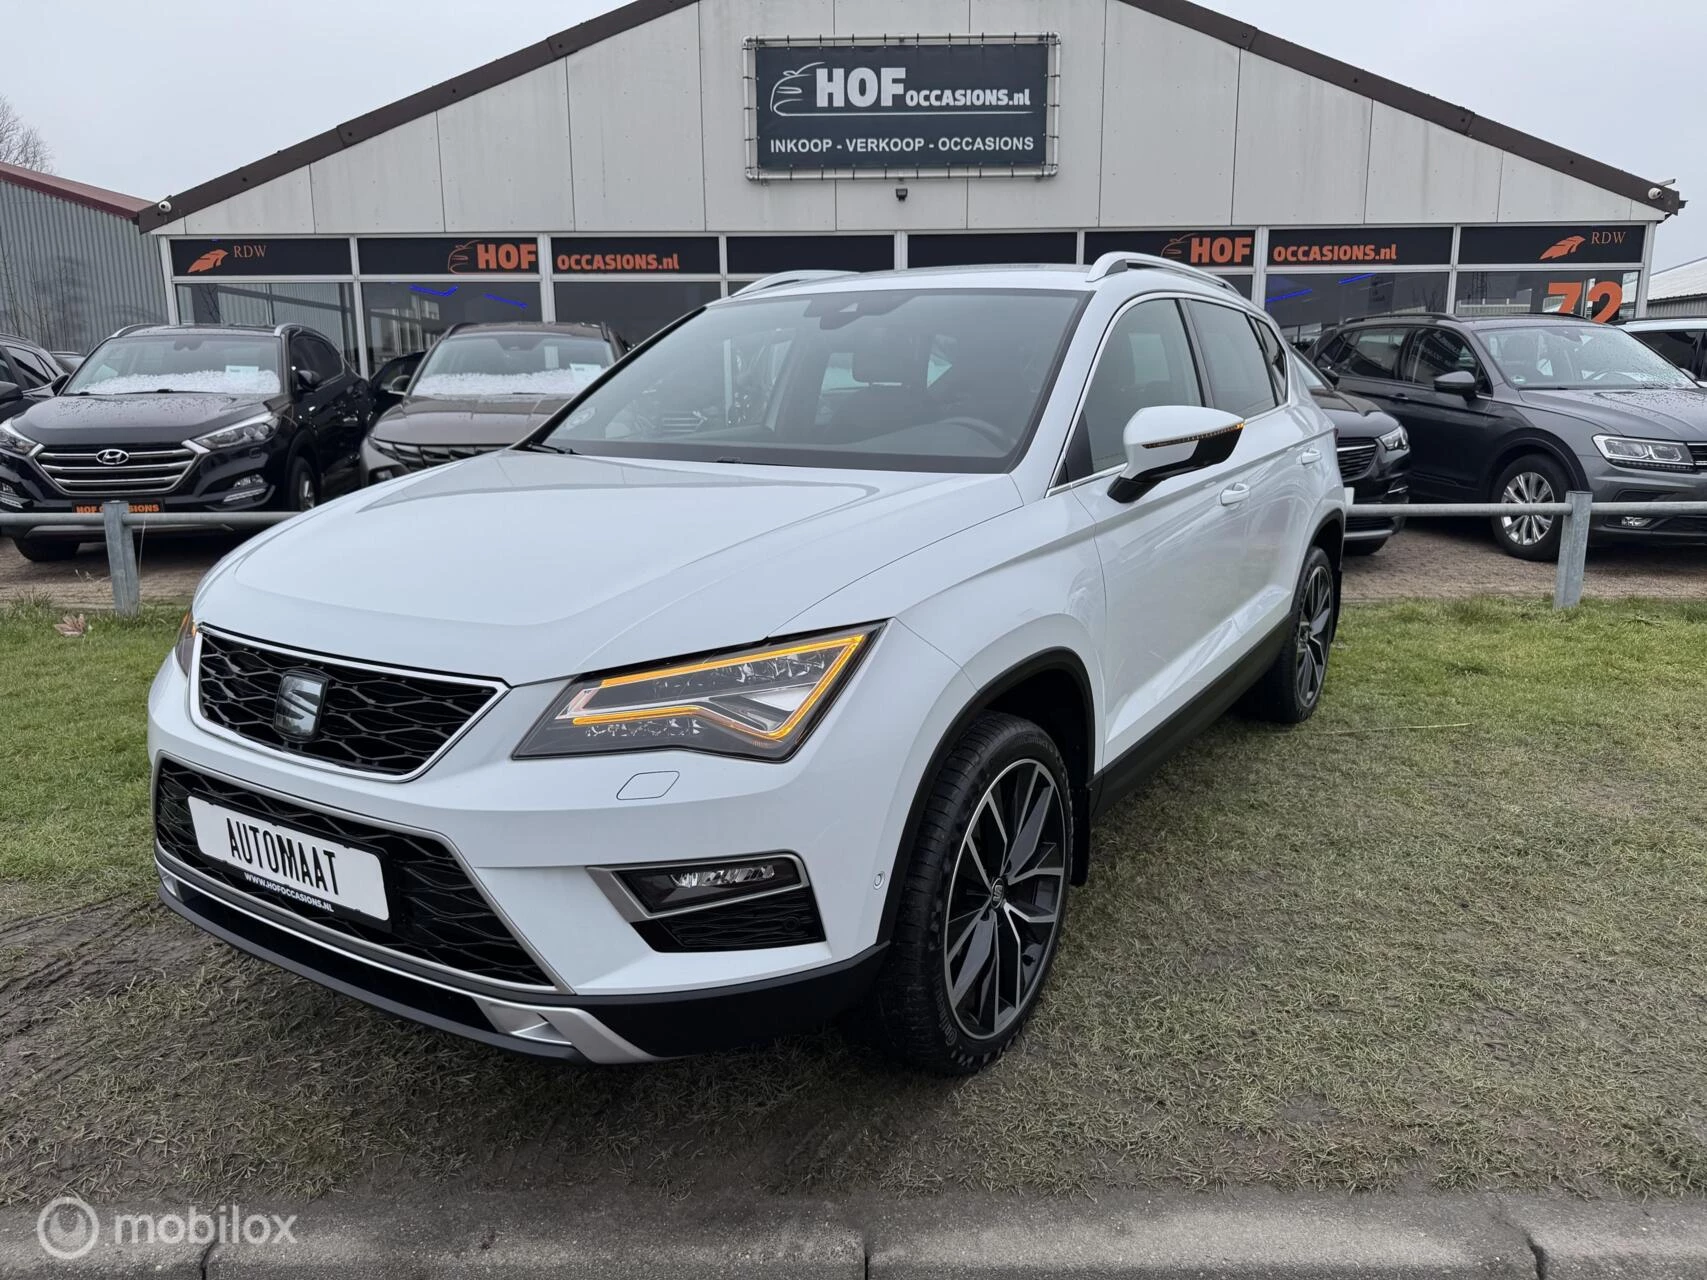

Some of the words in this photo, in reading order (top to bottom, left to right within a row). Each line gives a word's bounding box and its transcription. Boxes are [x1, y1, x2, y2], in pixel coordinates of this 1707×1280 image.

[815, 67, 906, 107] HOF
[770, 139, 832, 153] INKOOP
[846, 138, 925, 152] VERKOOP
[938, 136, 1034, 151] OCCASIONS
[1190, 237, 1252, 263] HOF
[1273, 244, 1397, 262] OCCASIONS.nl
[1591, 231, 1626, 244] RDW
[233, 245, 266, 258] RDW
[477, 243, 537, 270] HOF
[557, 253, 680, 270] OCCASIONS.nl
[1548, 281, 1623, 323] 72
[227, 817, 339, 895] AUTOMAAT
[243, 871, 335, 912] WWW.HOFOCCASIONS.NL
